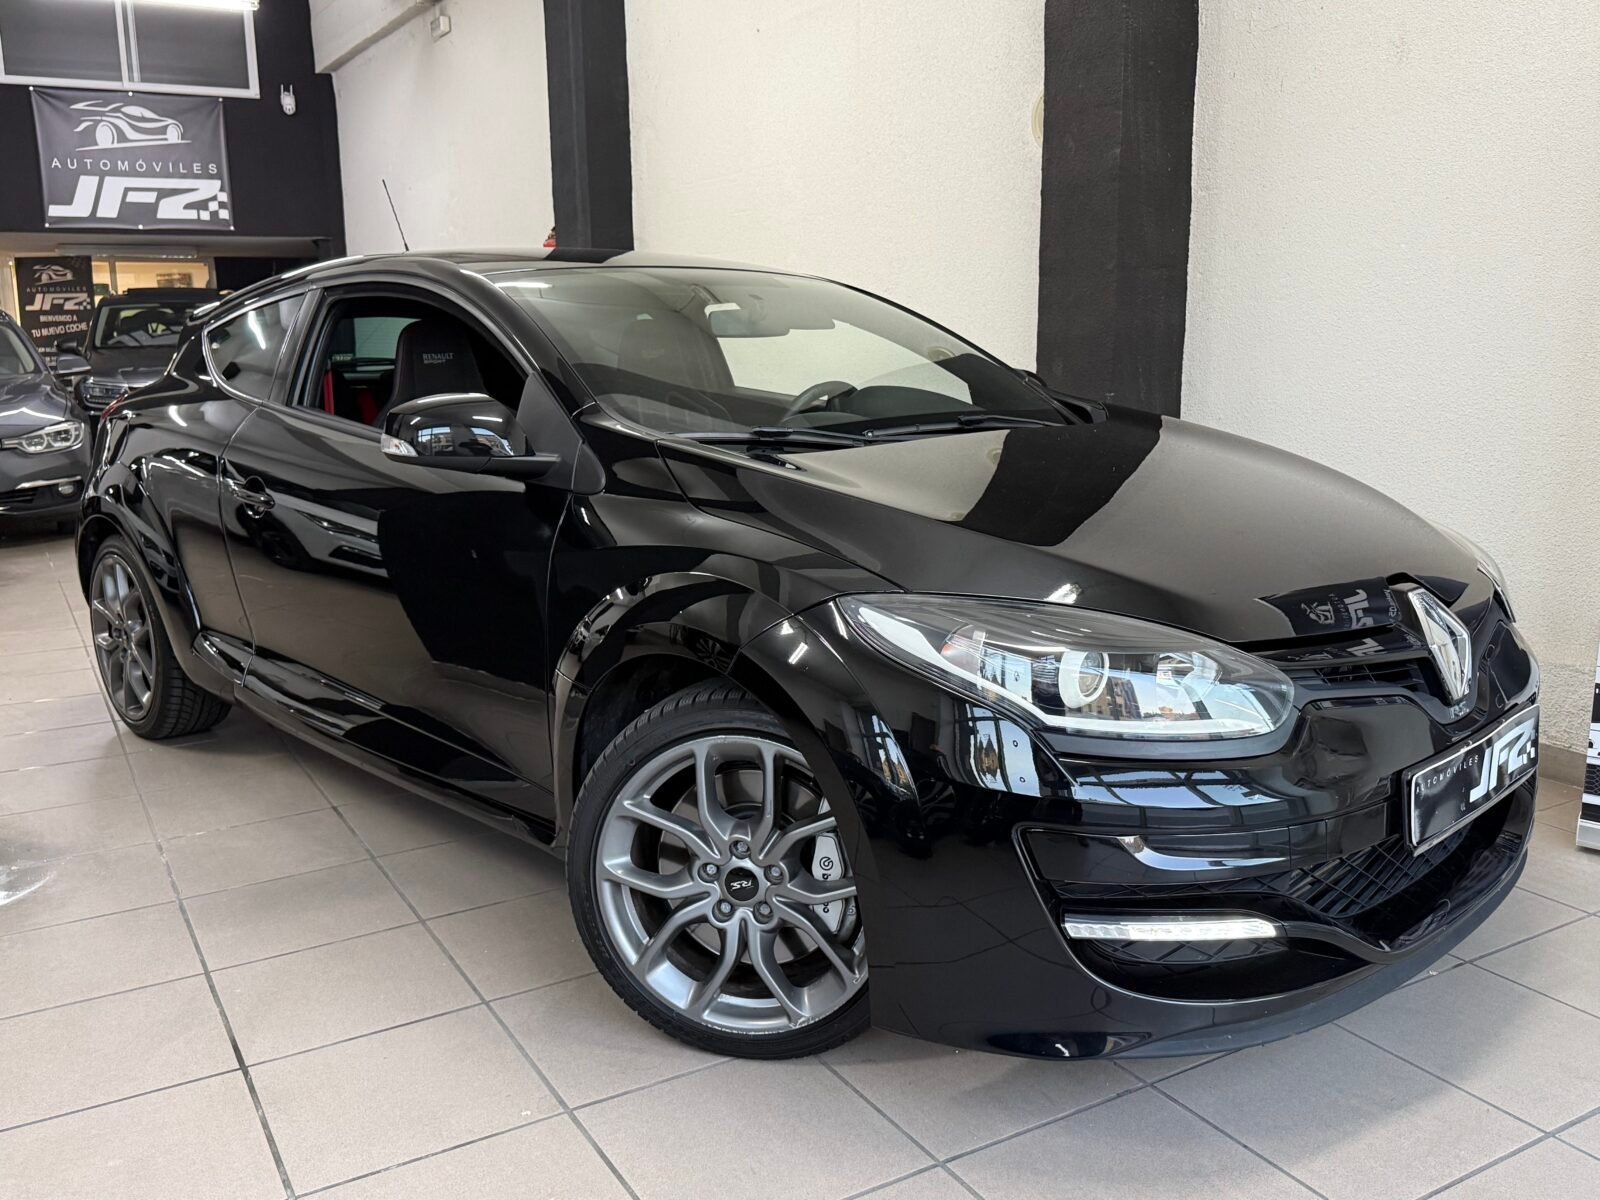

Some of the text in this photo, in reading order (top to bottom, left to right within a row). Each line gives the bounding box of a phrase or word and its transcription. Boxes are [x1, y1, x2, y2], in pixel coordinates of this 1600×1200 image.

[51, 158, 218, 174] AUTOMÓVILES
[48, 175, 226, 220] JFZ
[32, 322, 88, 337] TU NUEVO COCHE
[422, 352, 454, 360] RENAULT
[1469, 718, 1535, 803] JFZ
